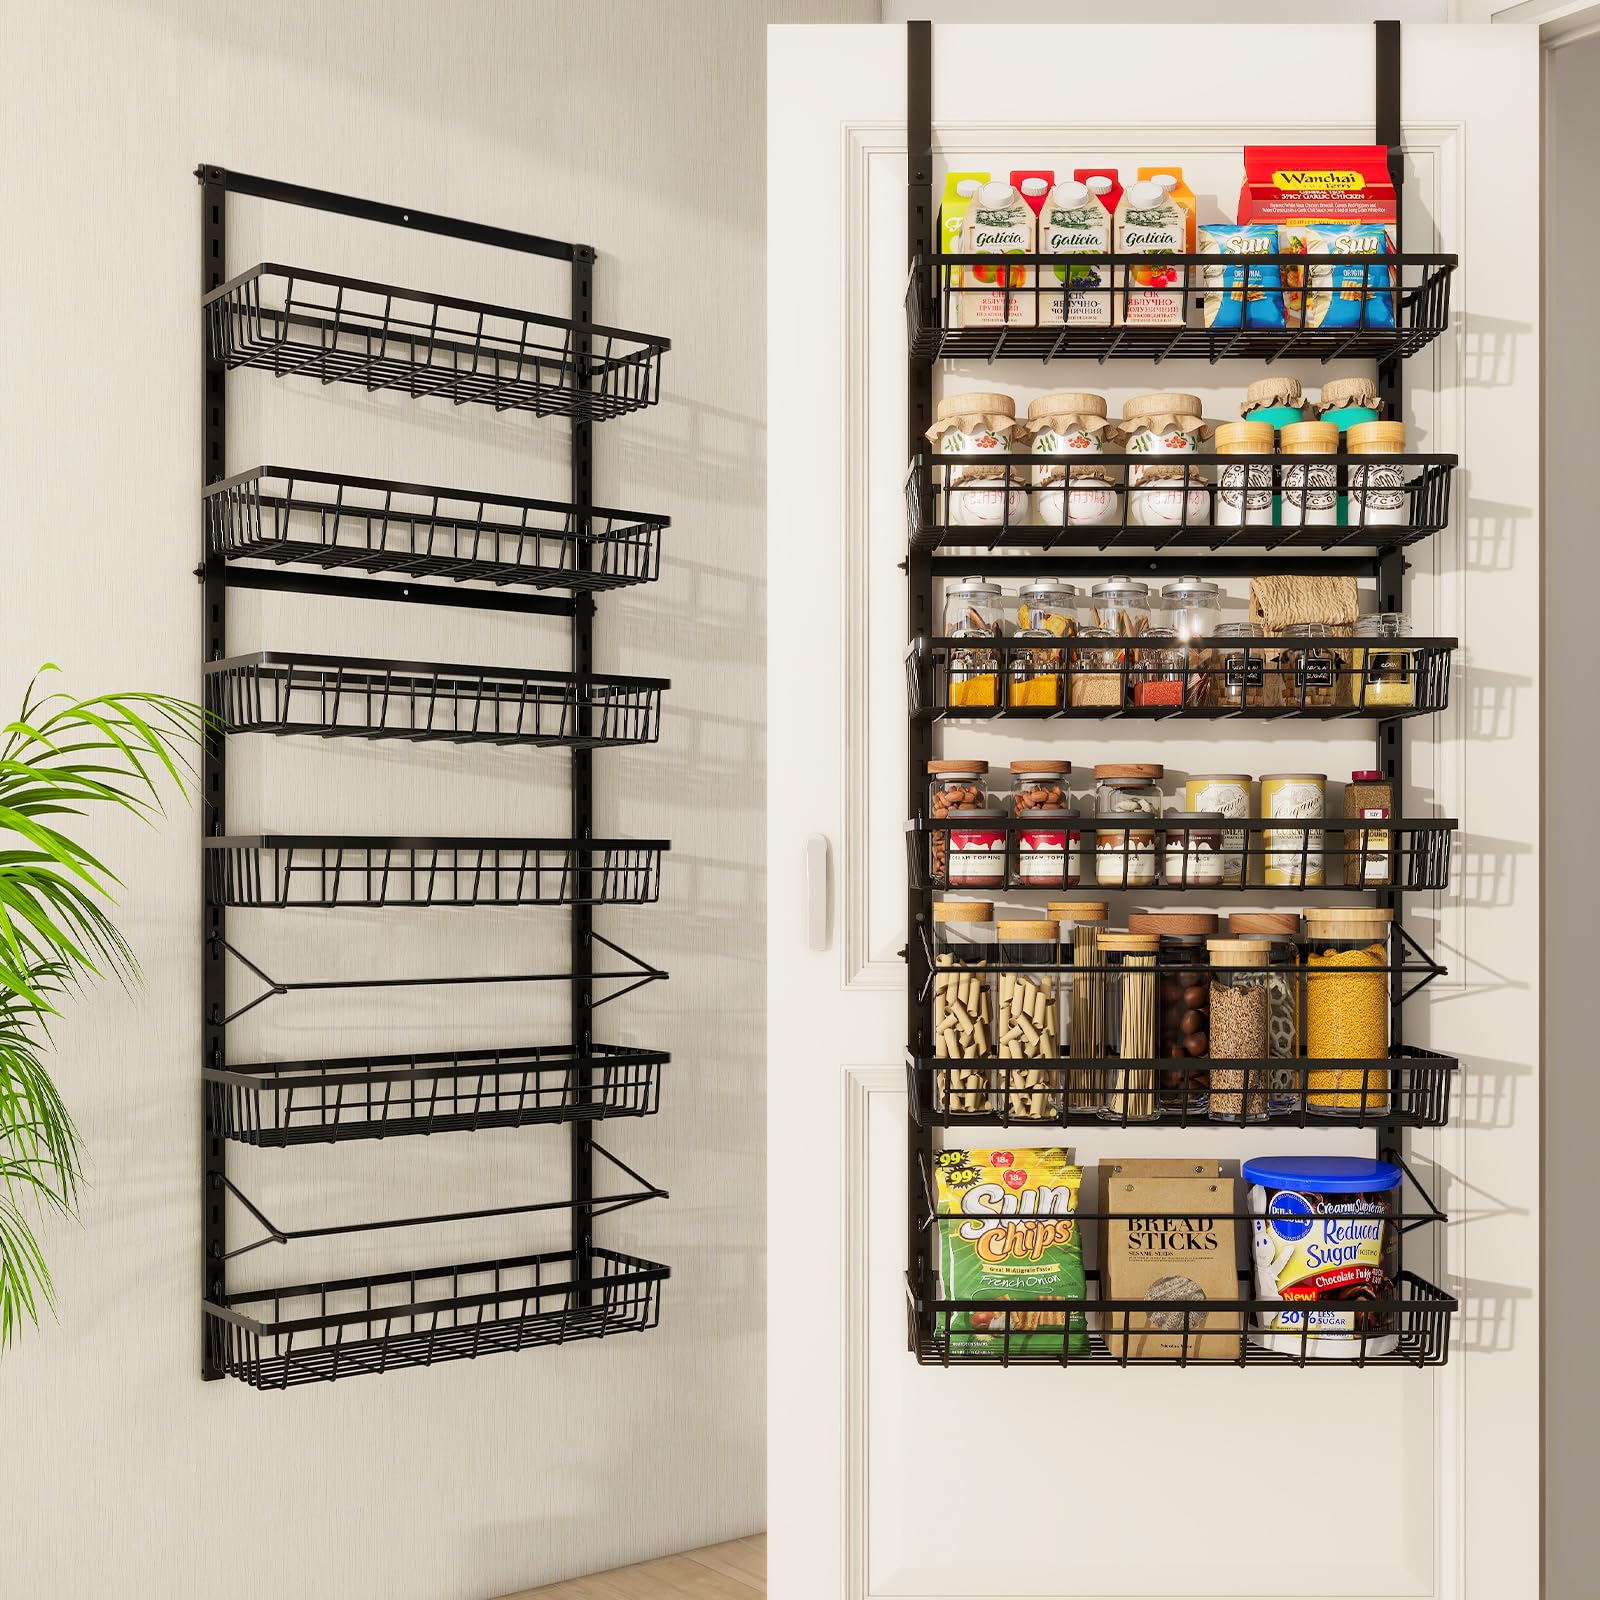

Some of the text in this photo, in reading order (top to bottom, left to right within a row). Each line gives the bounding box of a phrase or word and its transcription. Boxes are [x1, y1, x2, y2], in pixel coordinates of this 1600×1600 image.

[1280, 172, 1356, 184] Wanchai
[976, 231, 1025, 248] Galicia
[1050, 233, 1103, 249] Galicia
[1125, 231, 1177, 247] Galicia
[1226, 236, 1271, 254] Sun
[1334, 235, 1379, 254] Sun
[1053, 300, 1101, 308] ЯБУЧНО-
[959, 1183, 1076, 1240] Sun
[1126, 1216, 1215, 1233] BREAD
[1323, 1216, 1381, 1245] Reduced
[976, 1220, 1074, 1261] Chips
[1127, 1231, 1219, 1251] STICKS
[1306, 1242, 1362, 1269] Sugar
[979, 1274, 1061, 1288] French Onion
[1315, 1270, 1355, 1288] Chocolate
[1355, 1267, 1372, 1282] Fudge
[1283, 1291, 1316, 1302] New!
[1318, 1310, 1336, 1318] LESS
[1318, 1318, 1346, 1326] SUGAR
